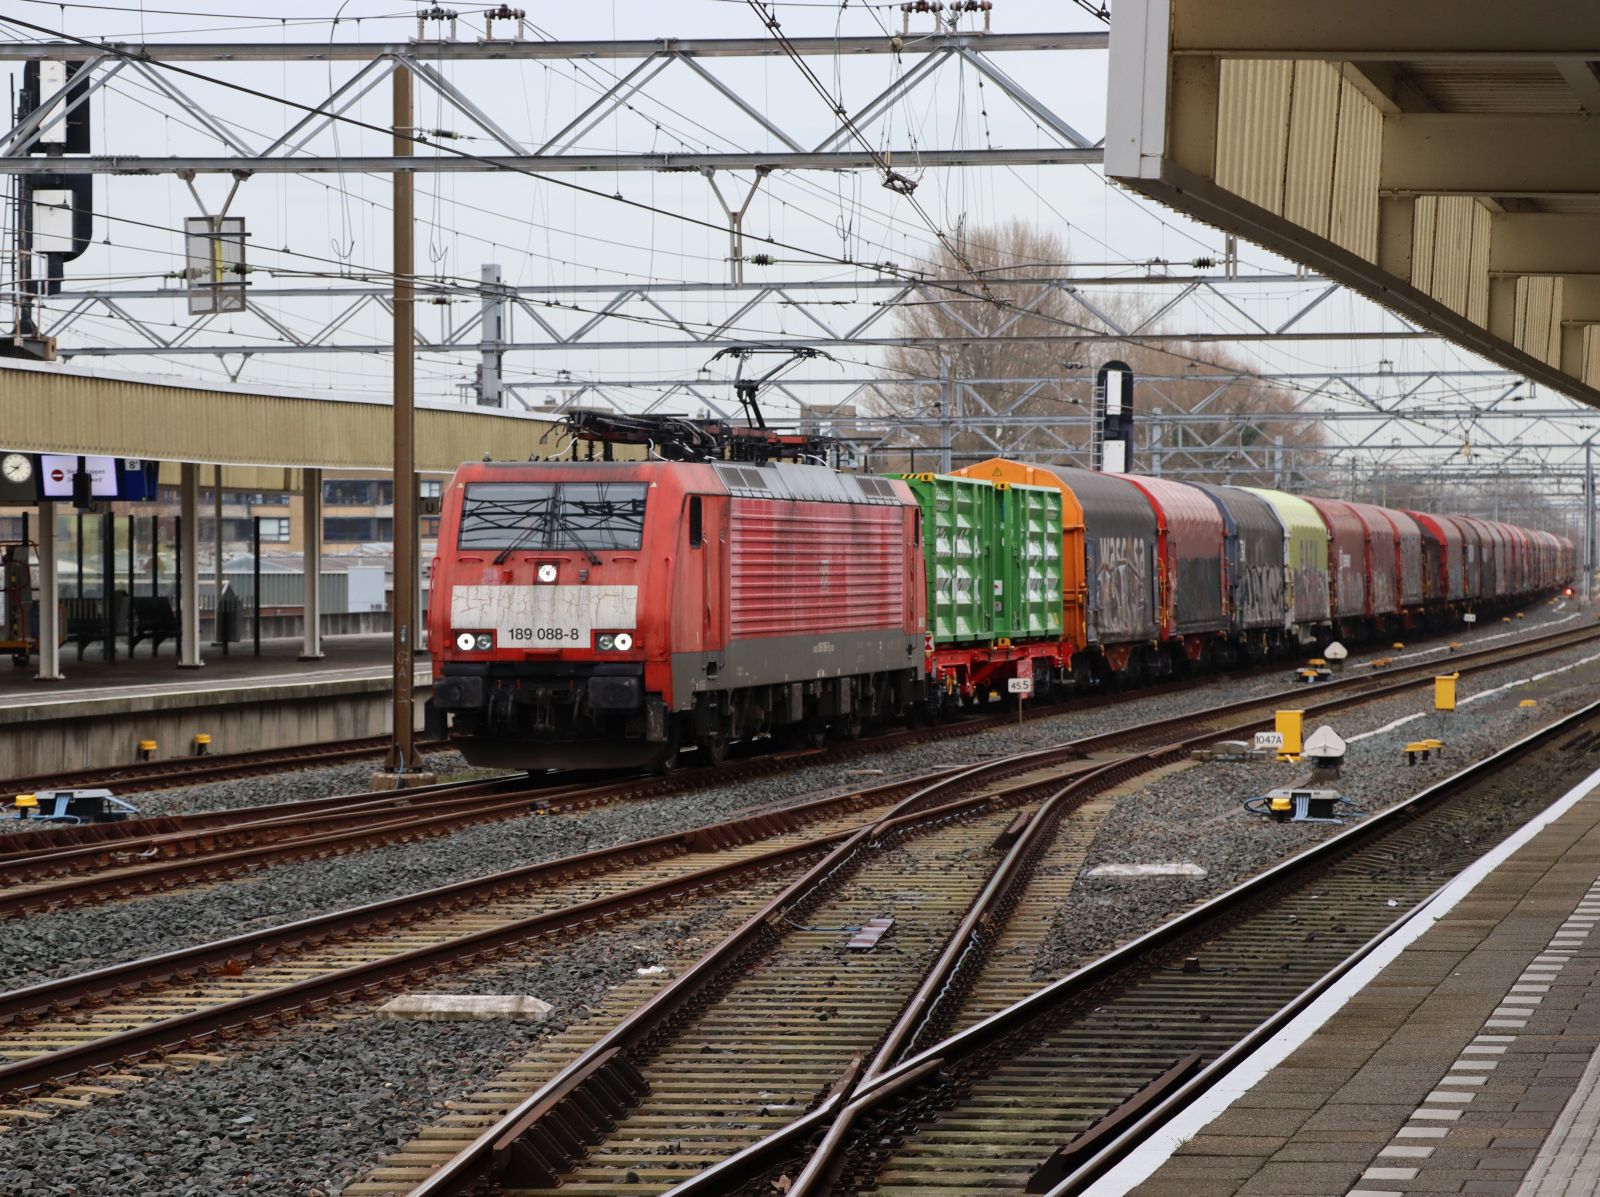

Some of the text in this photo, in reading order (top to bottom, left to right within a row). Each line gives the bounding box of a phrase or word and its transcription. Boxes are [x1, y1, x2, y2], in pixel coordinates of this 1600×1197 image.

[508, 627, 580, 640] 189 088-8
[1255, 735, 1282, 744] 1047A
